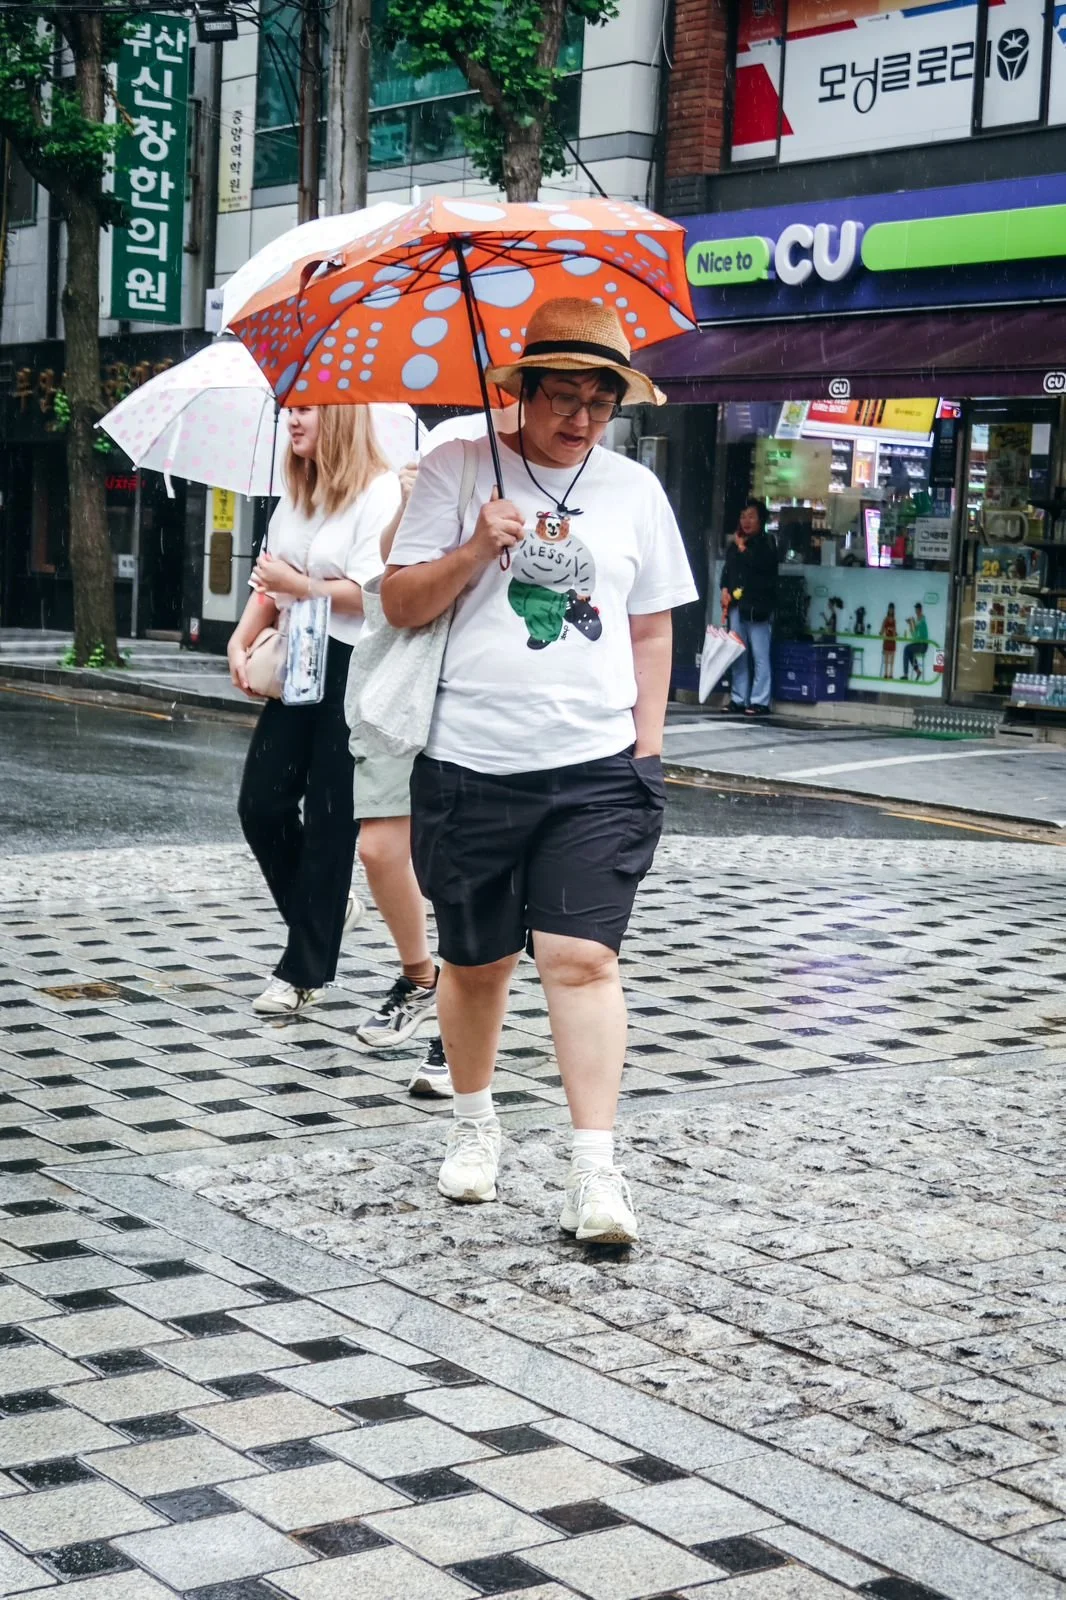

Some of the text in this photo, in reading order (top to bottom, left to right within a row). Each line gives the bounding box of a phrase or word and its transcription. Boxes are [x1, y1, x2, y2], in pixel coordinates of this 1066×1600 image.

[123, 22, 187, 64] 부산
[818, 40, 992, 113] 모닝글로리
[125, 66, 177, 312] 신창한의원
[697, 220, 864, 285] Nice to CU
[1047, 376, 1064, 389] CU
[529, 545, 565, 565] LESS
